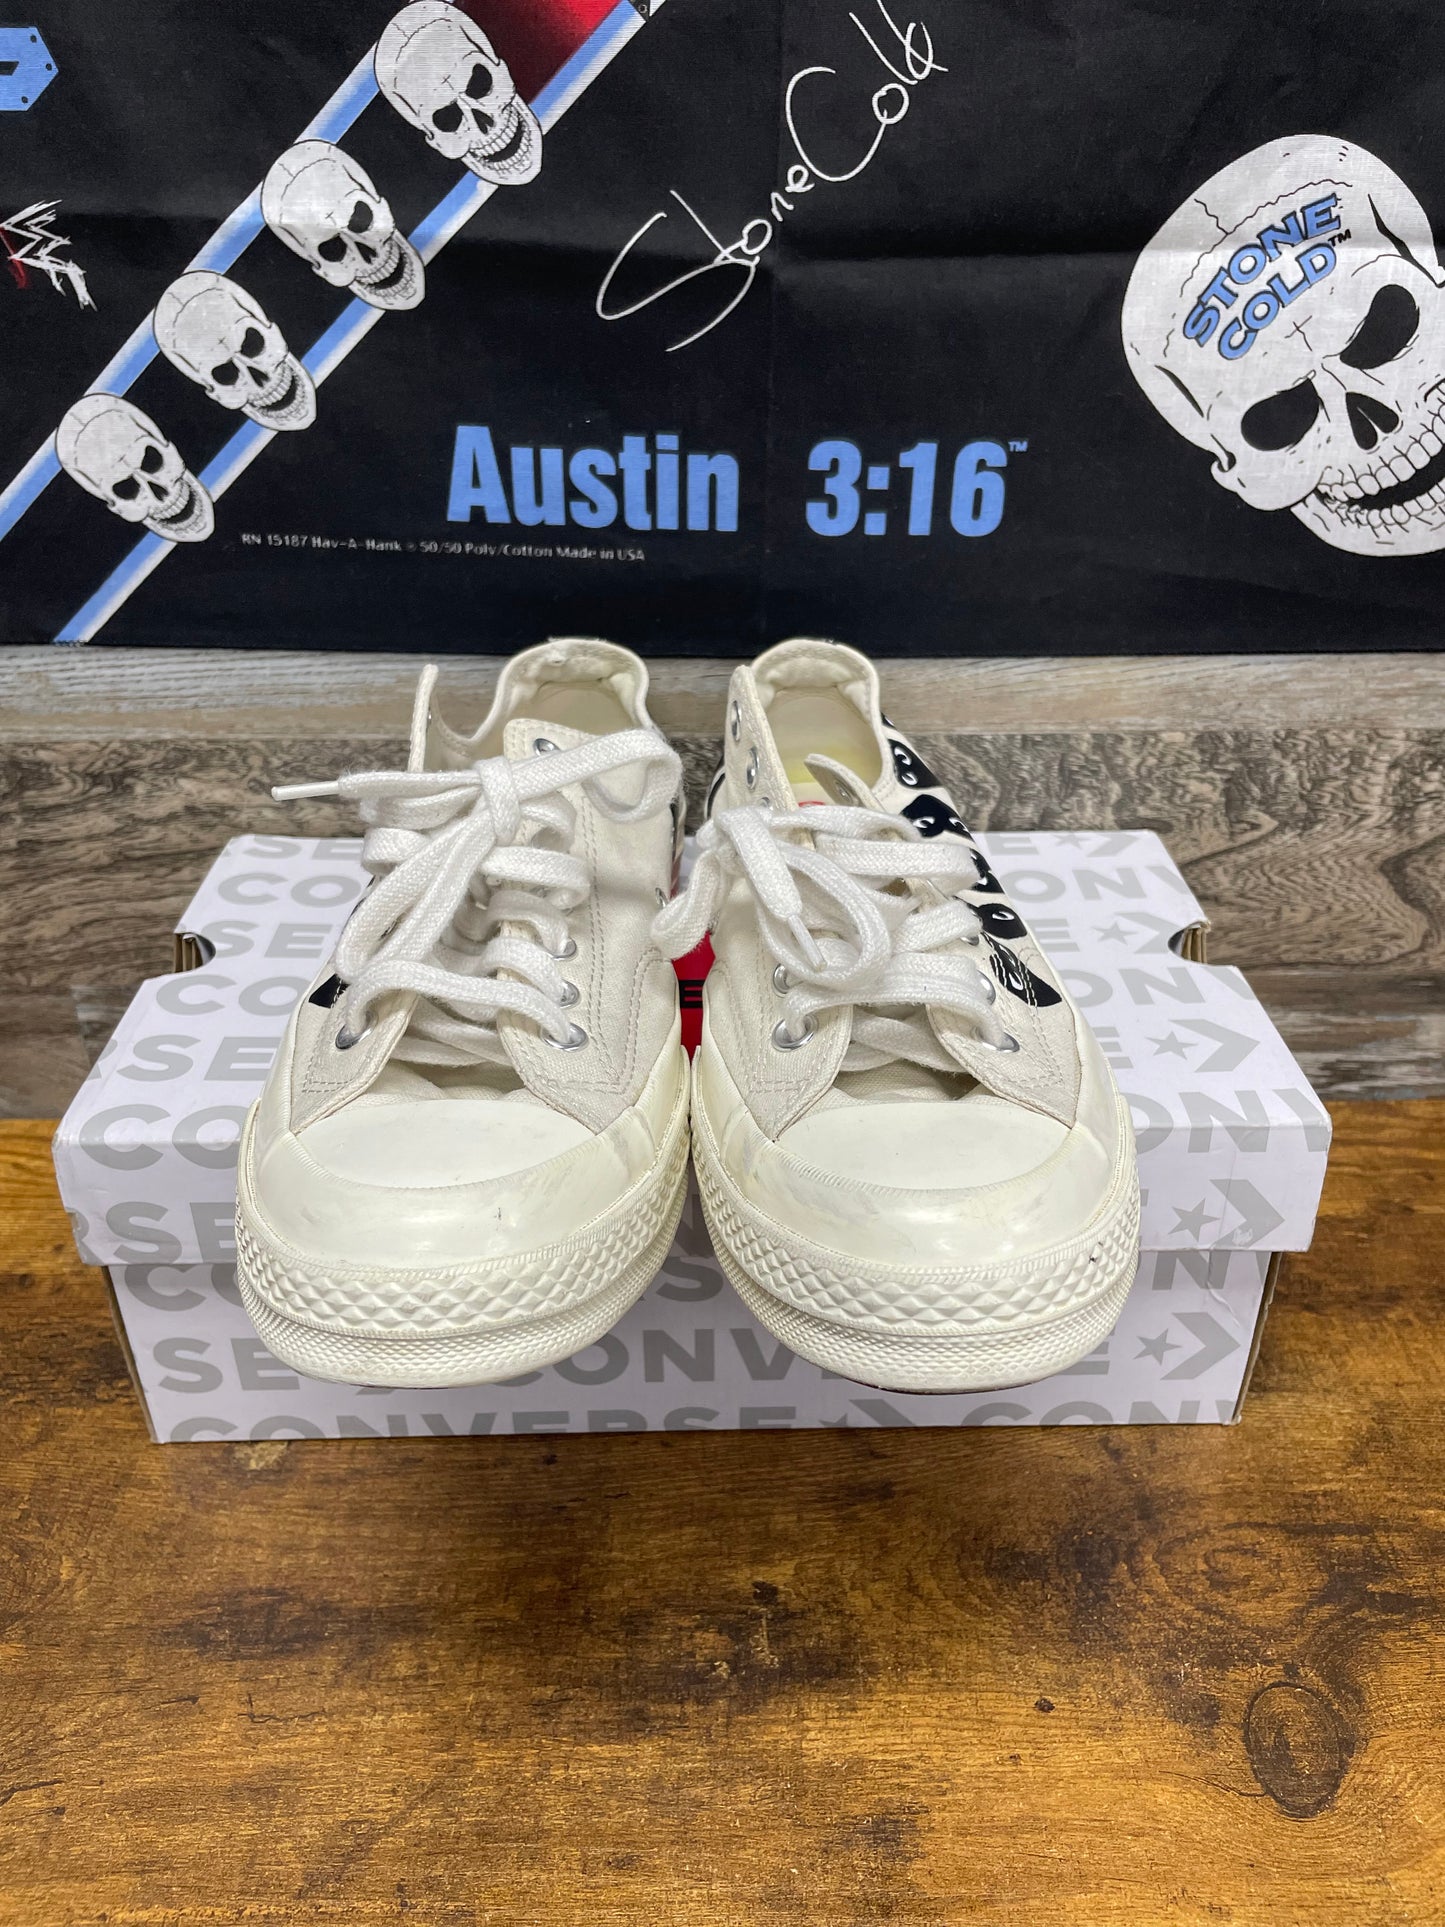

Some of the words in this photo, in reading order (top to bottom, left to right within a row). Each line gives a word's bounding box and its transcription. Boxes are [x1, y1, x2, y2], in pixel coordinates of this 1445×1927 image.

[1182, 192, 1341, 348] STONE
[1217, 242, 1338, 361] COLD
[446, 424, 739, 533] Austin
[240, 532, 262, 546] RN
[267, 533, 309, 548] 15187
[419, 540, 462, 555] 50/50
[556, 545, 597, 561] Made
[599, 547, 615, 561] in
[617, 548, 646, 562] USA
